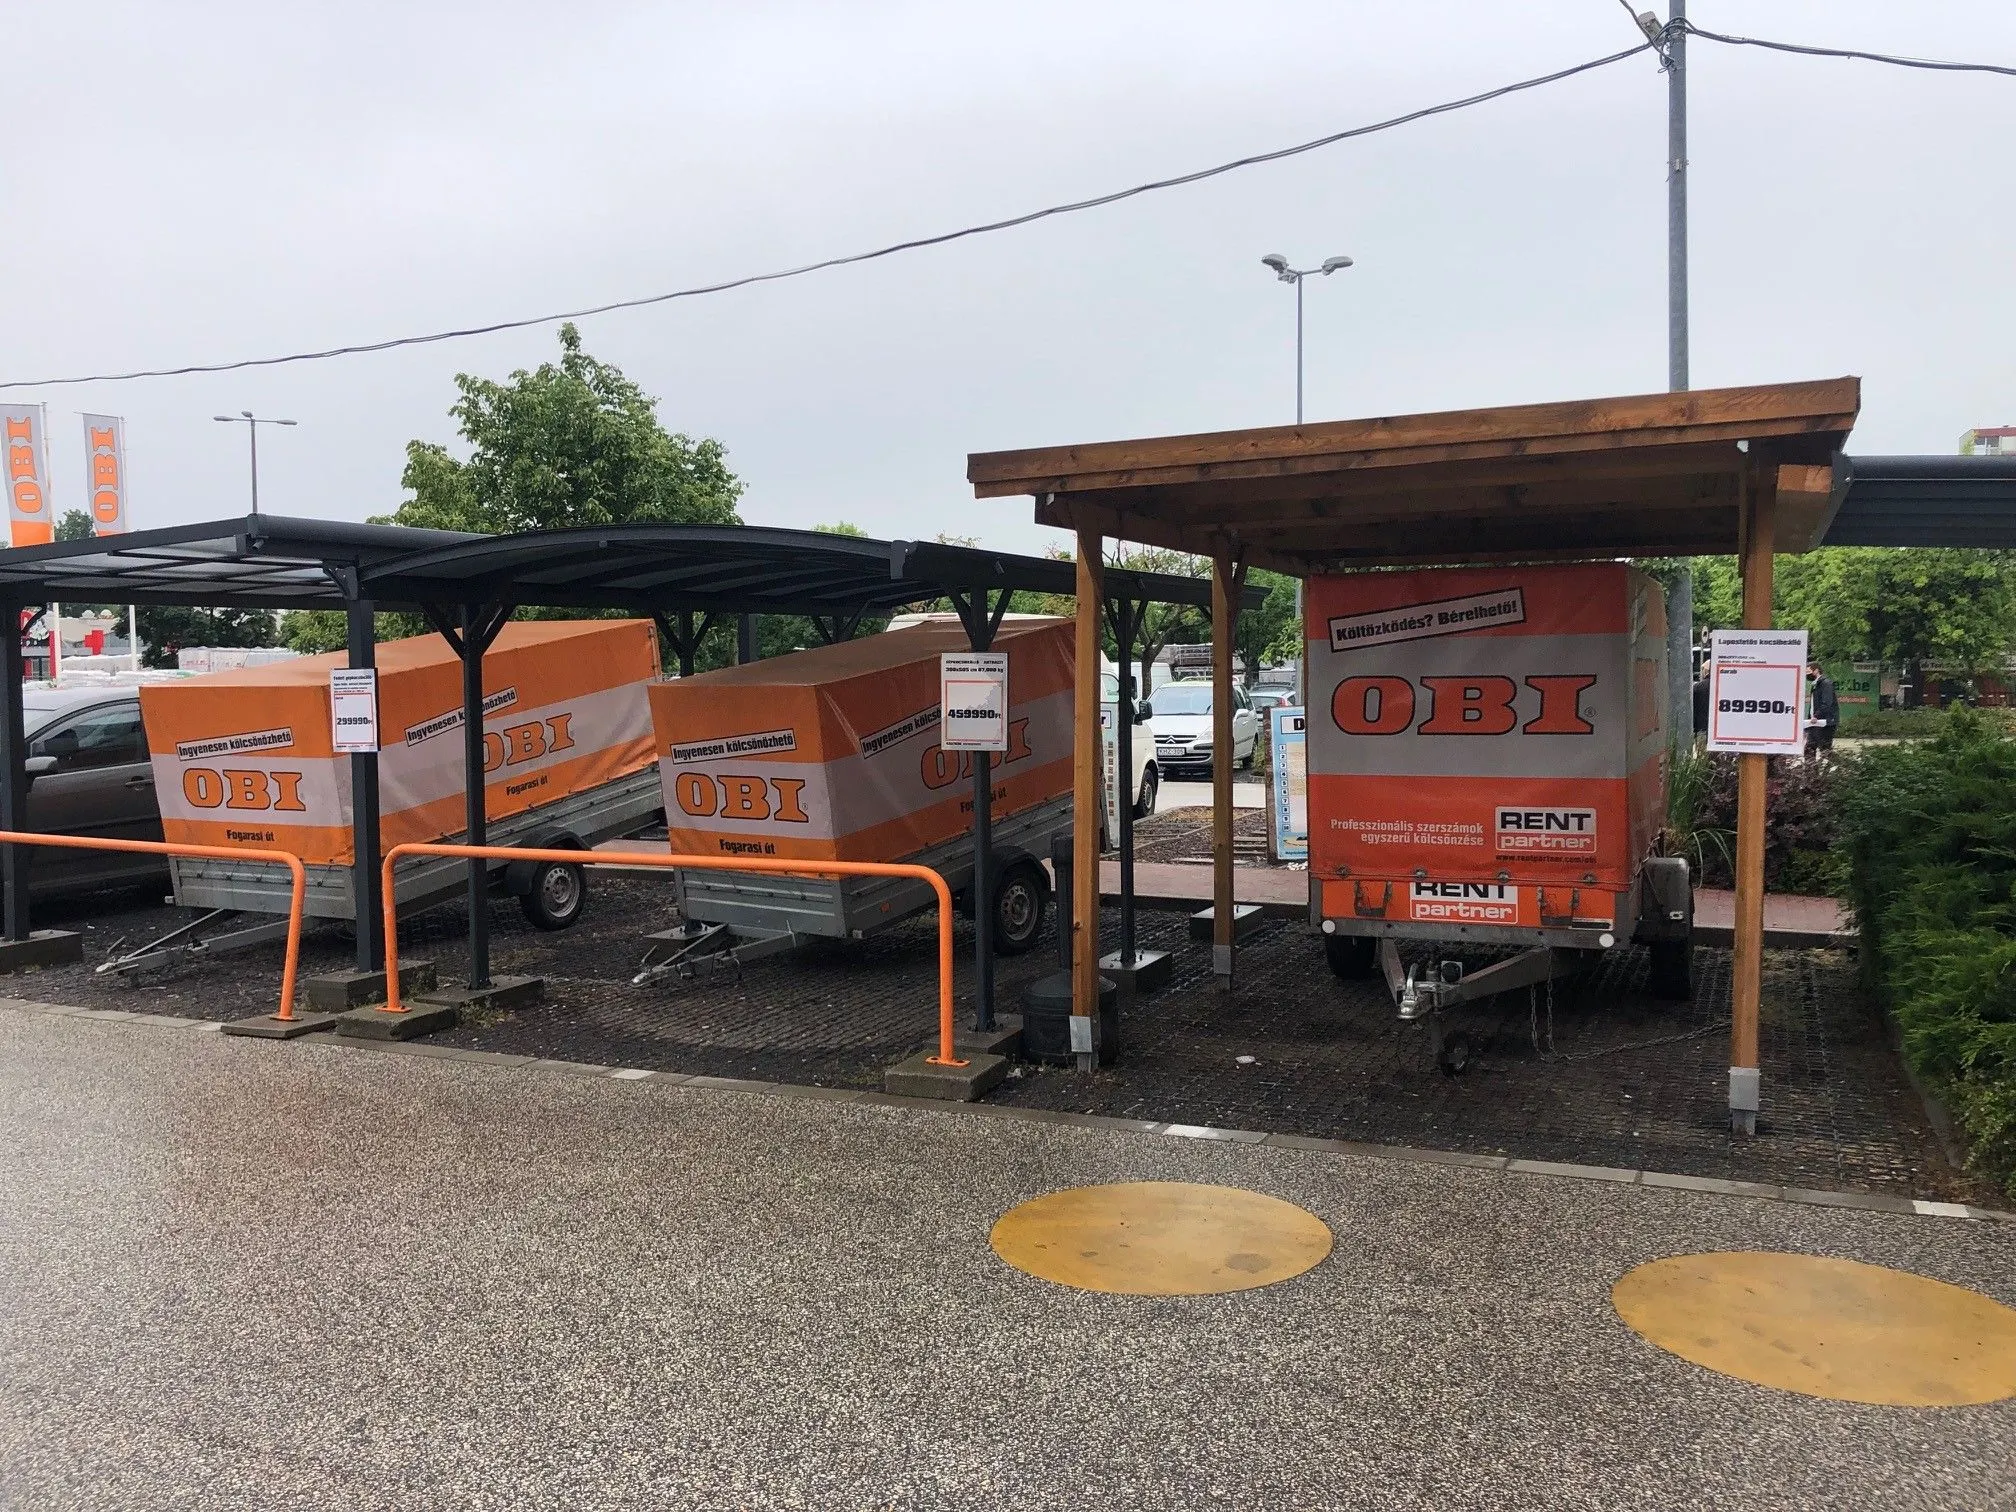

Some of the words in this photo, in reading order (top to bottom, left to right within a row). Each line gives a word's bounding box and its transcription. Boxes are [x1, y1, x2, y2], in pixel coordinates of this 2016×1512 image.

[6, 416, 43, 514] OBI
[90, 426, 119, 523] OBI
[1336, 613, 1434, 642] Költözködés?
[1331, 675, 1597, 736] OBI
[407, 714, 458, 741] Ingyenesen
[862, 722, 914, 753] Ingyenesen
[178, 743, 229, 758] Ingyenesen
[230, 730, 292, 750] kölcsönözhető
[673, 744, 725, 761] Ingyenesen
[726, 732, 794, 753] kölcsönözhető
[183, 768, 306, 812] OBI
[506, 778, 539, 797] Fogarasi
[676, 772, 809, 823] OBI
[1331, 818, 1414, 833] Professzionális
[1416, 821, 1484, 834] szerszámok
[1500, 811, 1591, 831] RENT
[226, 829, 264, 843] Fogarasi
[265, 831, 275, 842] út
[719, 838, 763, 854] Fogarasi
[764, 843, 775, 855] út
[1413, 833, 1484, 846] kölcsönzése
[1501, 834, 1591, 850] partner
[1414, 882, 1508, 899] RENT
[1415, 901, 1513, 919] partner
